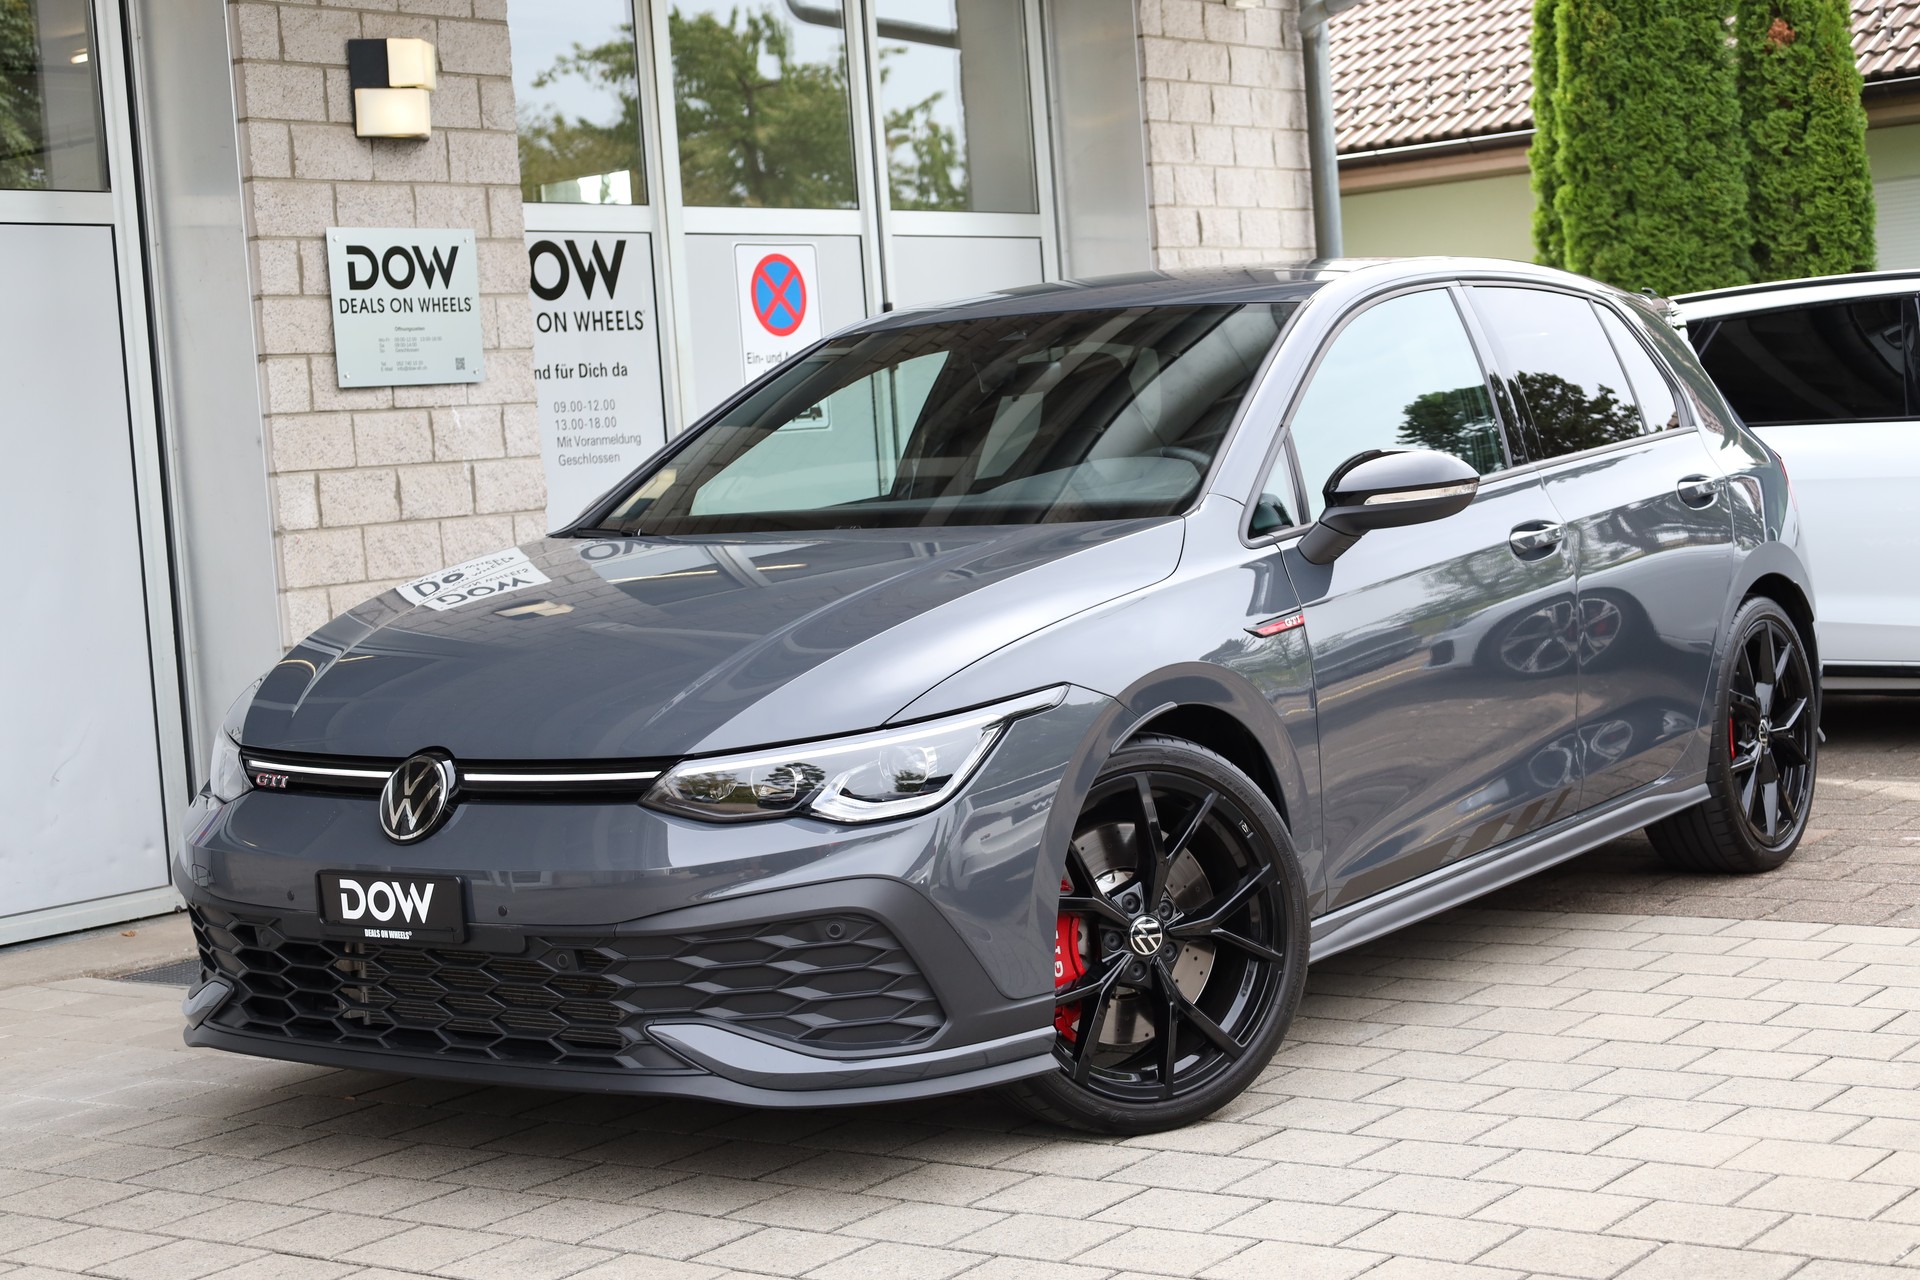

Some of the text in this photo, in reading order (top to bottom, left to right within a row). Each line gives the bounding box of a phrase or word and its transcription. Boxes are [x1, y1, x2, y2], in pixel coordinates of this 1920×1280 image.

[346, 245, 459, 290] DOW
[528, 240, 627, 301] OW
[339, 298, 385, 314] DEALS
[390, 297, 414, 313] ON
[536, 312, 567, 333] ON
[746, 352, 763, 364] Ein-
[766, 351, 783, 363] und
[534, 361, 628, 380] nd für Dich da
[553, 399, 616, 414] 09.00-12.00
[555, 416, 617, 431] 13.00-18.00
[556, 433, 642, 448] Mit Voranmeldung
[558, 453, 621, 466] Geschlossen
[1284, 614, 1302, 627] GTI
[256, 772, 289, 789] GTI
[339, 878, 435, 924] DOW
[364, 928, 381, 938] DEALS
[381, 929, 389, 939] ON
